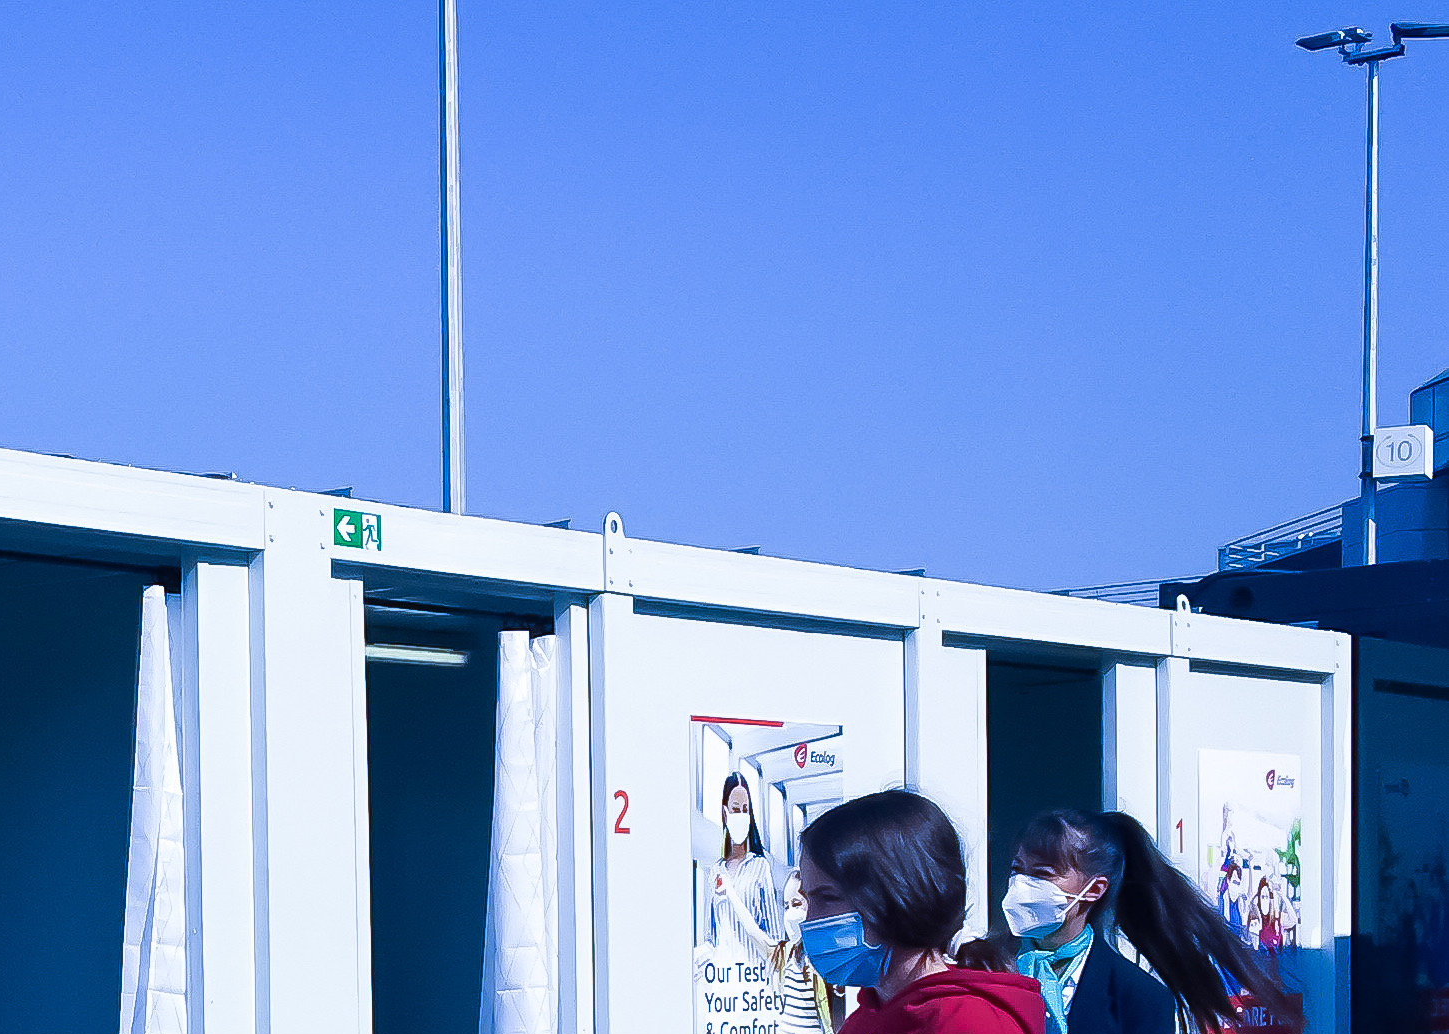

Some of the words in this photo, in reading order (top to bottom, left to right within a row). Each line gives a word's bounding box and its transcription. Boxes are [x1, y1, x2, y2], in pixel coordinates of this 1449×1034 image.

[1386, 440, 1413, 462] 10
[810, 750, 836, 768] Ecolog
[613, 789, 631, 835] 2
[1175, 817, 1184, 854] 1
[704, 962, 732, 984] Our
[735, 962, 770, 986] Test,
[704, 992, 739, 1013] Your
[742, 988, 787, 1015] Safety
